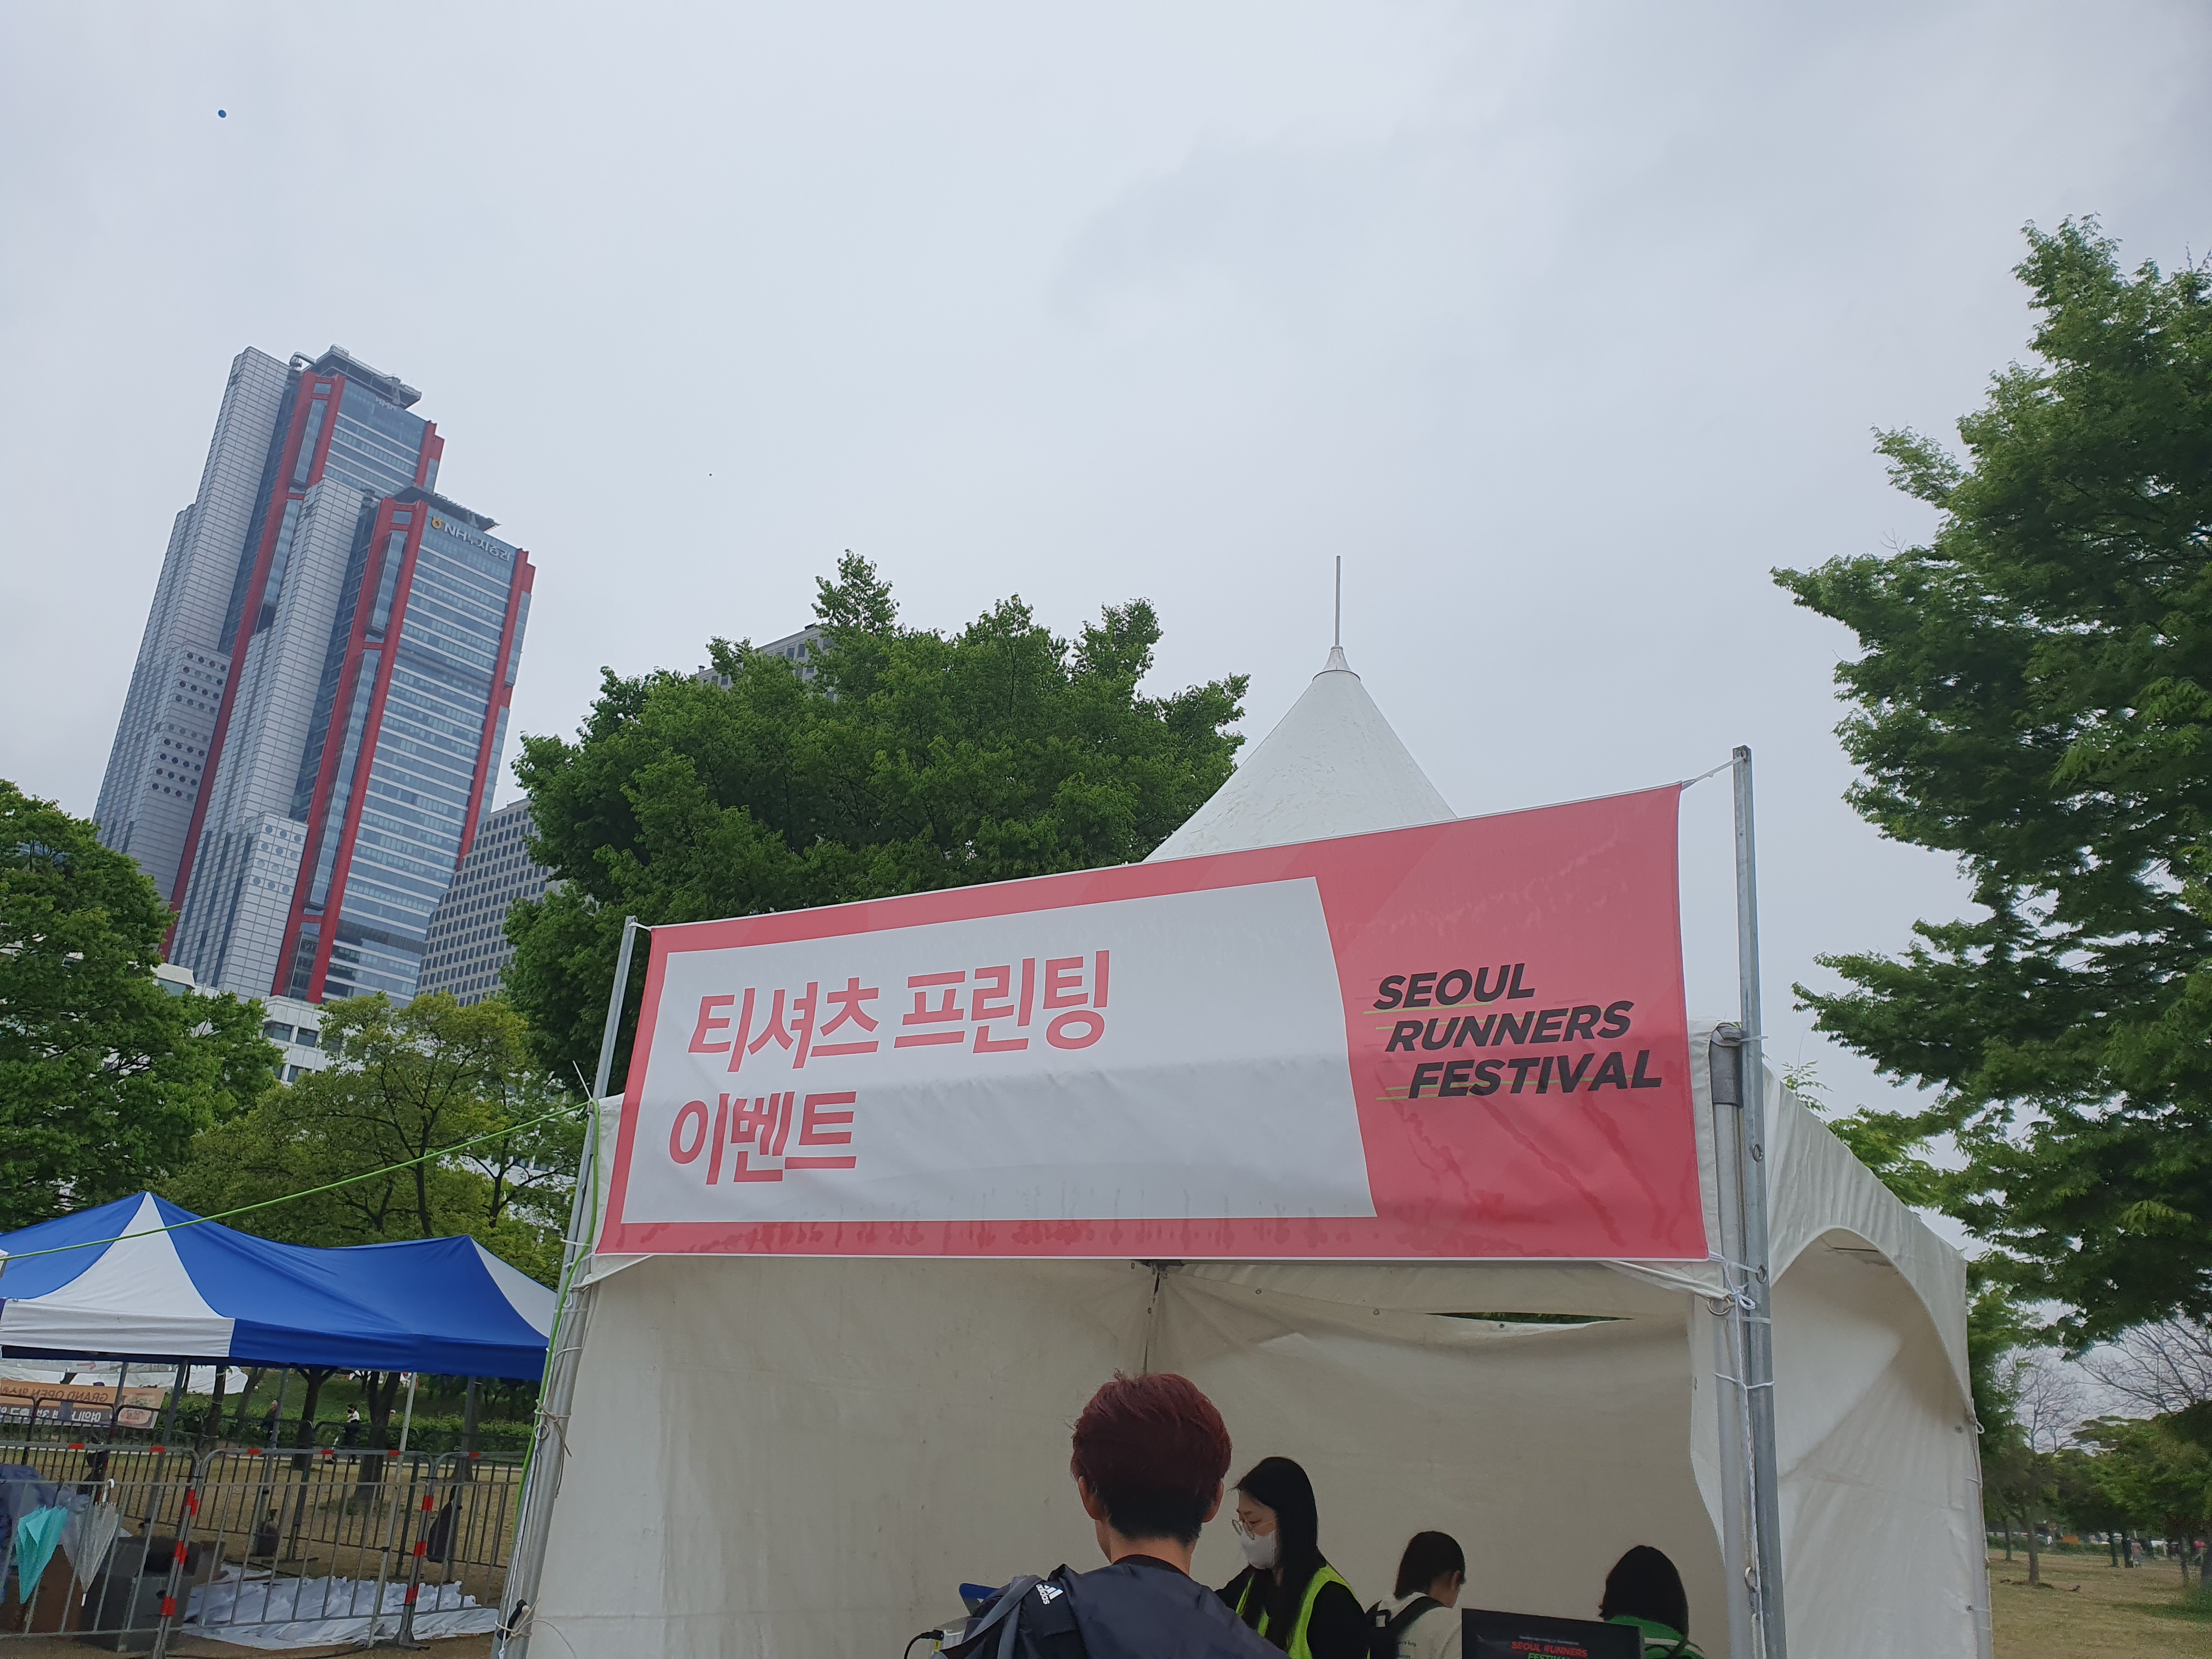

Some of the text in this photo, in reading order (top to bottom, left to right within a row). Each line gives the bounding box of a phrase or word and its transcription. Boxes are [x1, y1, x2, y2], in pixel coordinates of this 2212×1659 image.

[687, 950, 1110, 1073] 티셔츠 프린팅
[1372, 962, 1536, 1011] SEOUL
[1384, 1000, 1635, 1052] RUNNERS
[1408, 1049, 1662, 1099] FESTIVAL
[669, 1091, 857, 1186] 이벤트
[1035, 1584, 1051, 1605] adidas
[1511, 1641, 1588, 1657] SEOUL RUNNERS
